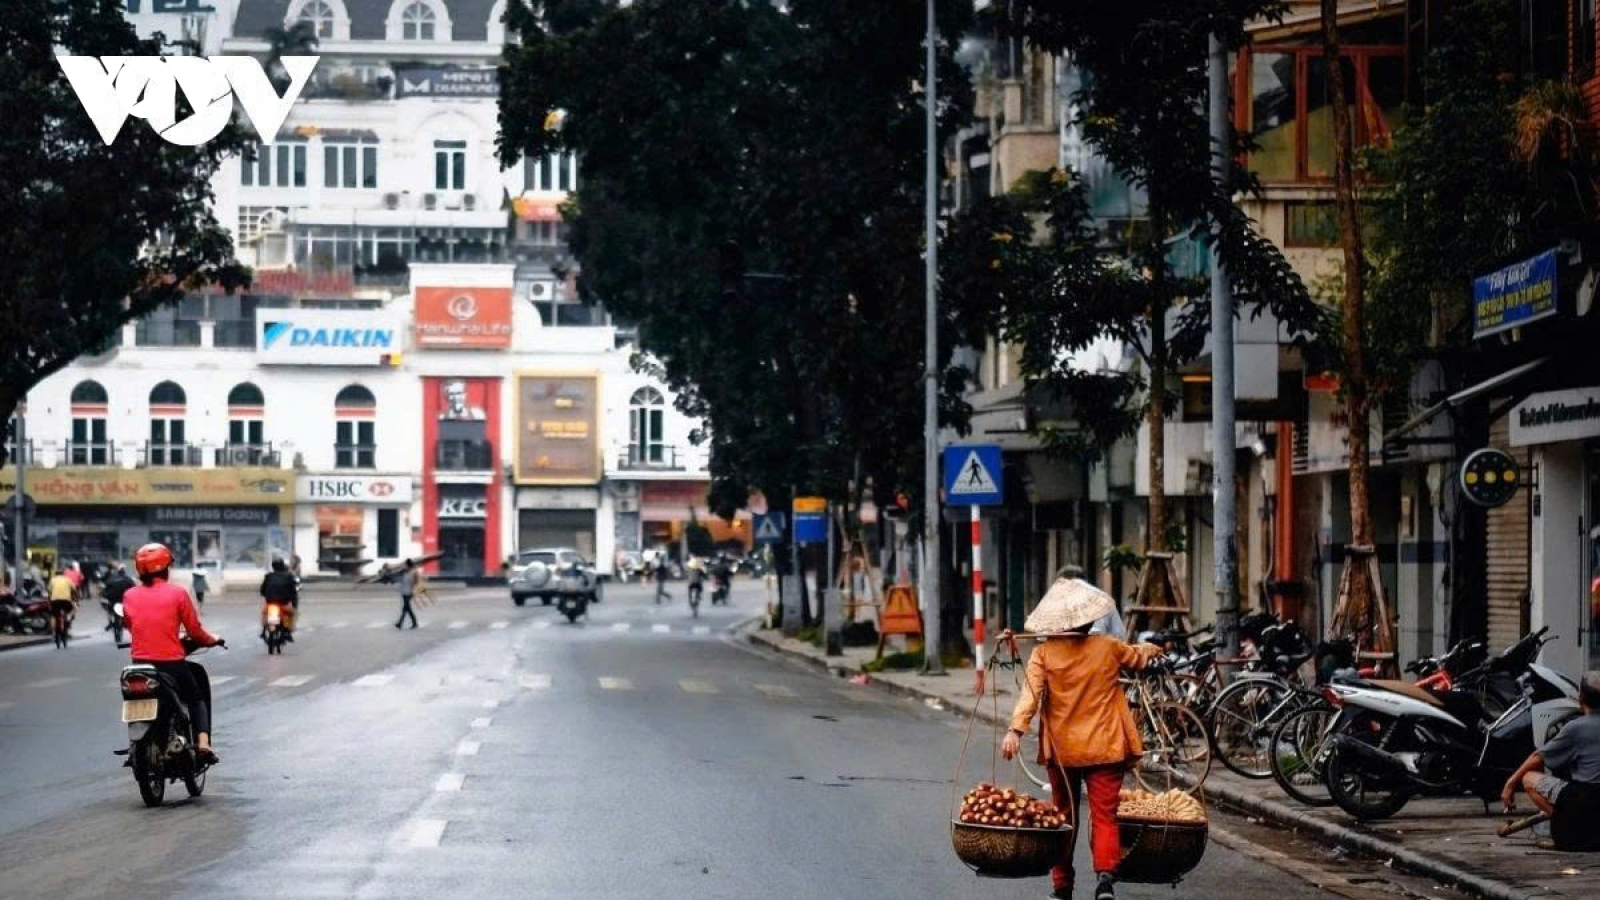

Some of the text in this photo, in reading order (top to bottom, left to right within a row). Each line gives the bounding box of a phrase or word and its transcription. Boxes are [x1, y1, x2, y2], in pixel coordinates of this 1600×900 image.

[289, 328, 394, 347] DAIKIN
[309, 480, 362, 497] HSBC
[156, 508, 270, 522] SAMSUNG Galaxy
[439, 498, 488, 516] KFC
